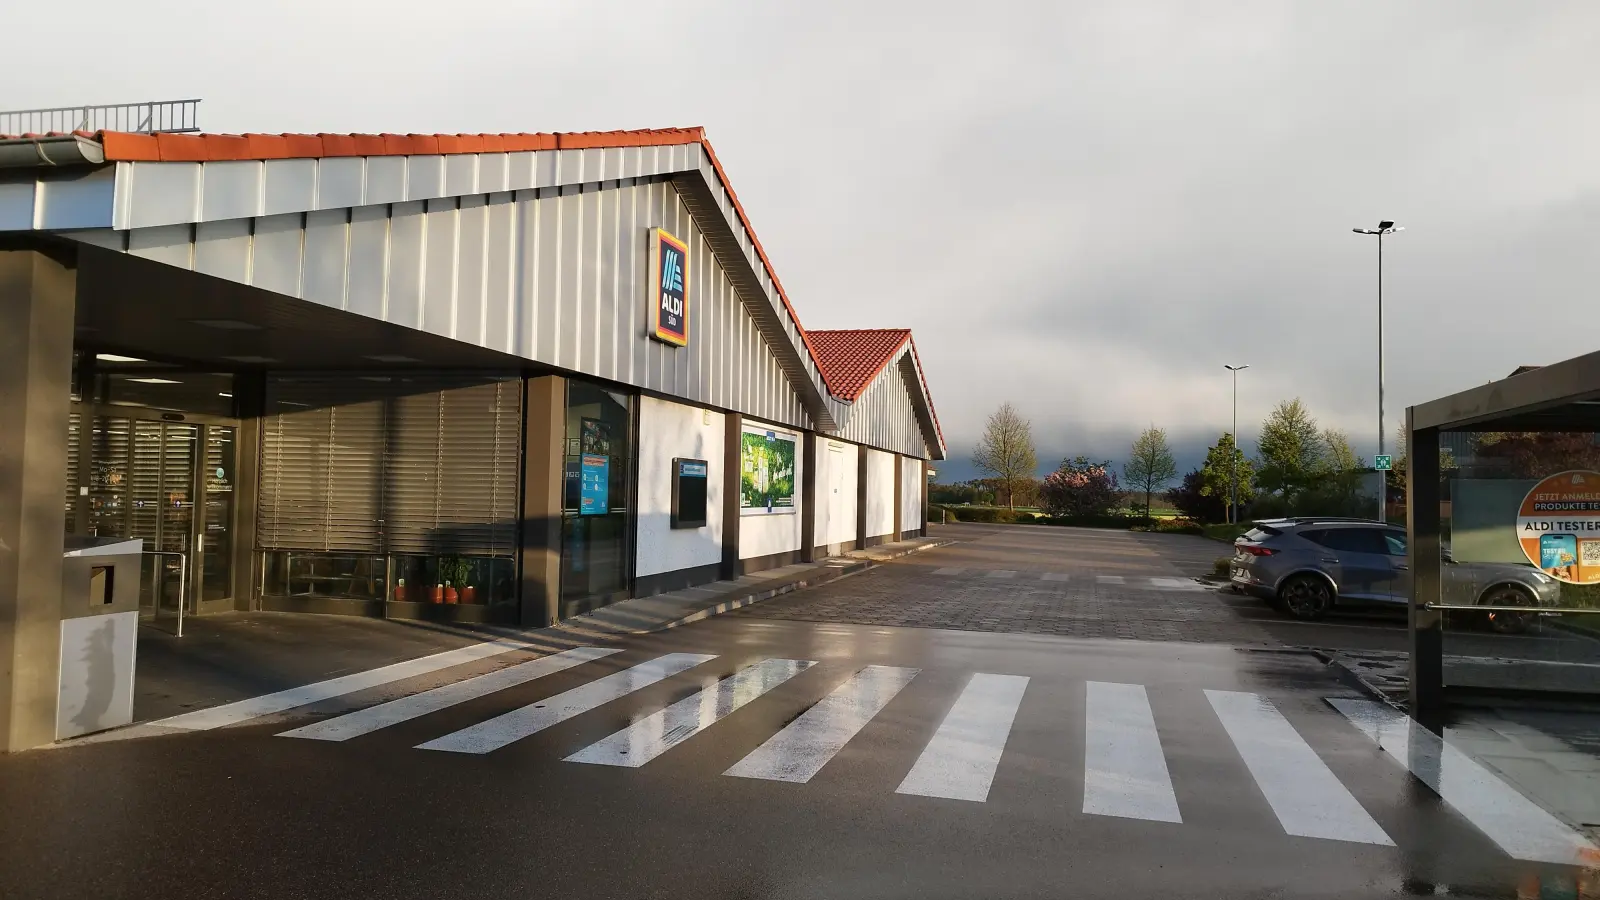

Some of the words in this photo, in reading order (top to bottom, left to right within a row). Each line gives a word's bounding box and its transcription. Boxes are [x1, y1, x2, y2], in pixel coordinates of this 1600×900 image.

[662, 292, 682, 317] ALDI
[1534, 493, 1560, 501] JETZT
[1535, 502, 1586, 511] PRODUKTE
[1588, 502, 1600, 510] TE
[1525, 521, 1554, 531] ALDI
[1556, 521, 1600, 531] TESTER
